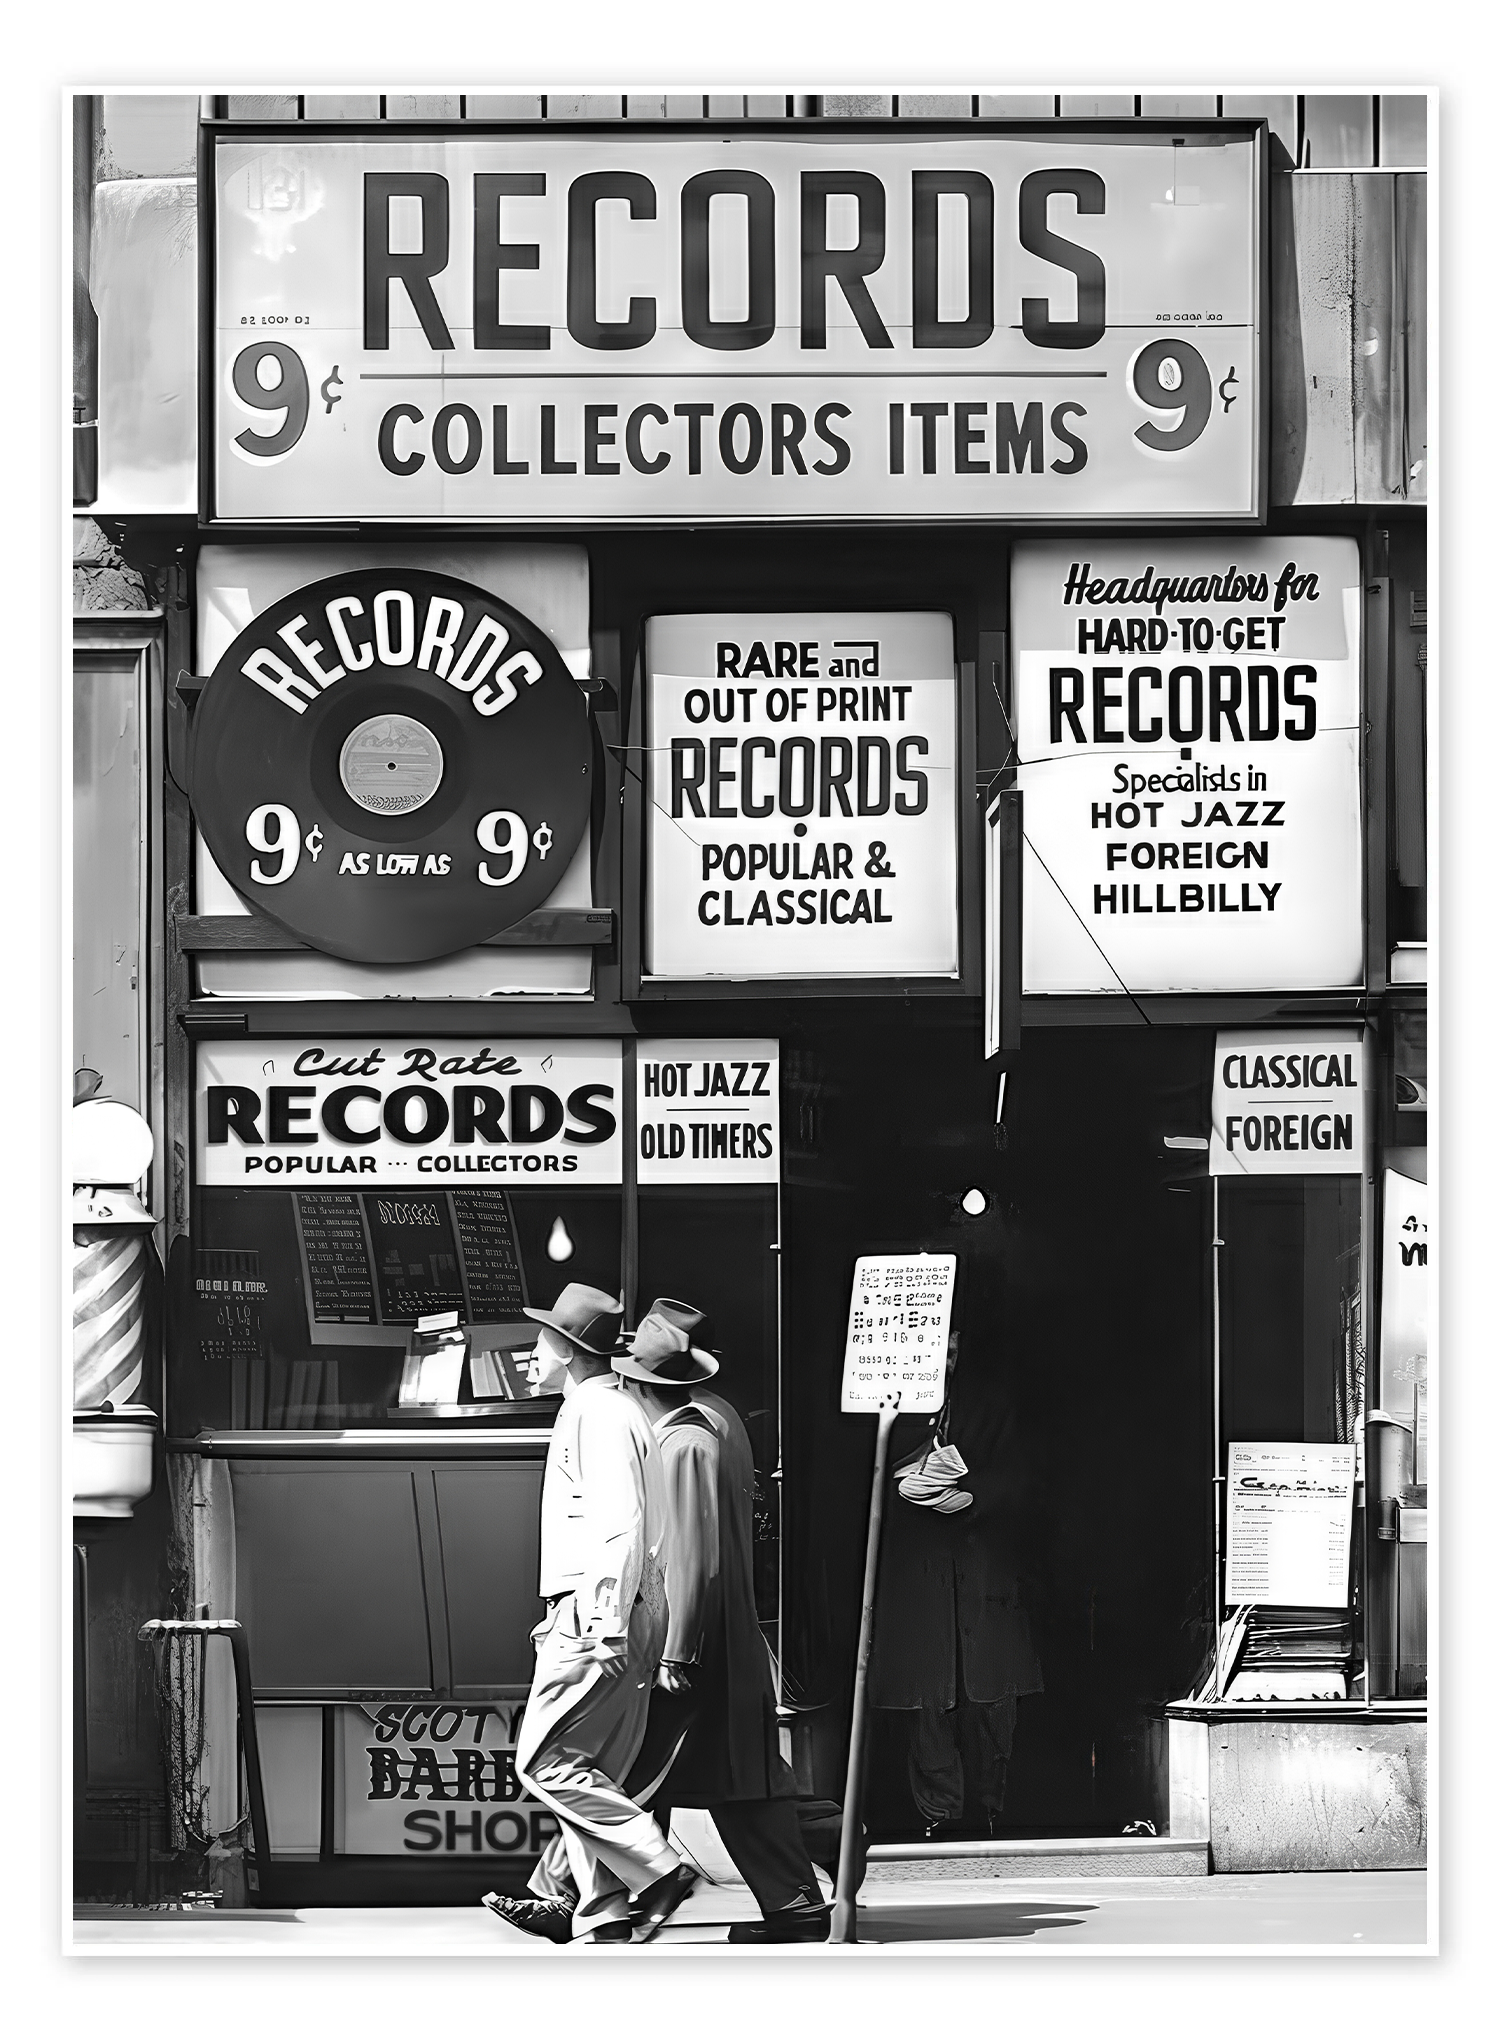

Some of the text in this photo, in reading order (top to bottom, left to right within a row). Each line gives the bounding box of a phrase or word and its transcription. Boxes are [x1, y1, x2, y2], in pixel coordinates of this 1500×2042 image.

[363, 168, 1106, 351] RECORDS
[378, 402, 1088, 476] COLLECTORS ITEMS
[1273, 561, 1320, 613] for
[240, 590, 543, 716] RECORDS
[716, 641, 879, 679] RARE and
[684, 686, 912, 724] OUT OF PRINT
[1049, 664, 1318, 745] RECORDS
[670, 735, 929, 820] RECORDS
[1247, 763, 1268, 792] in
[1091, 801, 1286, 829] HOT JAZZ
[338, 852, 370, 875] AS
[422, 853, 452, 875] AS
[702, 840, 896, 881] POPULAR &
[1106, 841, 1269, 871] FOREIGN
[698, 888, 892, 926] CLASSICAL
[1094, 882, 1283, 915] HILLBILLY
[293, 1047, 523, 1082] Cut Rate
[644, 1062, 771, 1098] HOT JAZZ
[1222, 1053, 1358, 1089] CLASSICAL
[206, 1083, 617, 1146] RECORDS
[1225, 1113, 1353, 1152] FOREIGN
[640, 1123, 686, 1160] OLD
[244, 1154, 578, 1174] POPULAR COLLECTORS
[365, 1747, 540, 1803] BARB
[403, 1809, 562, 1851] SHOP
